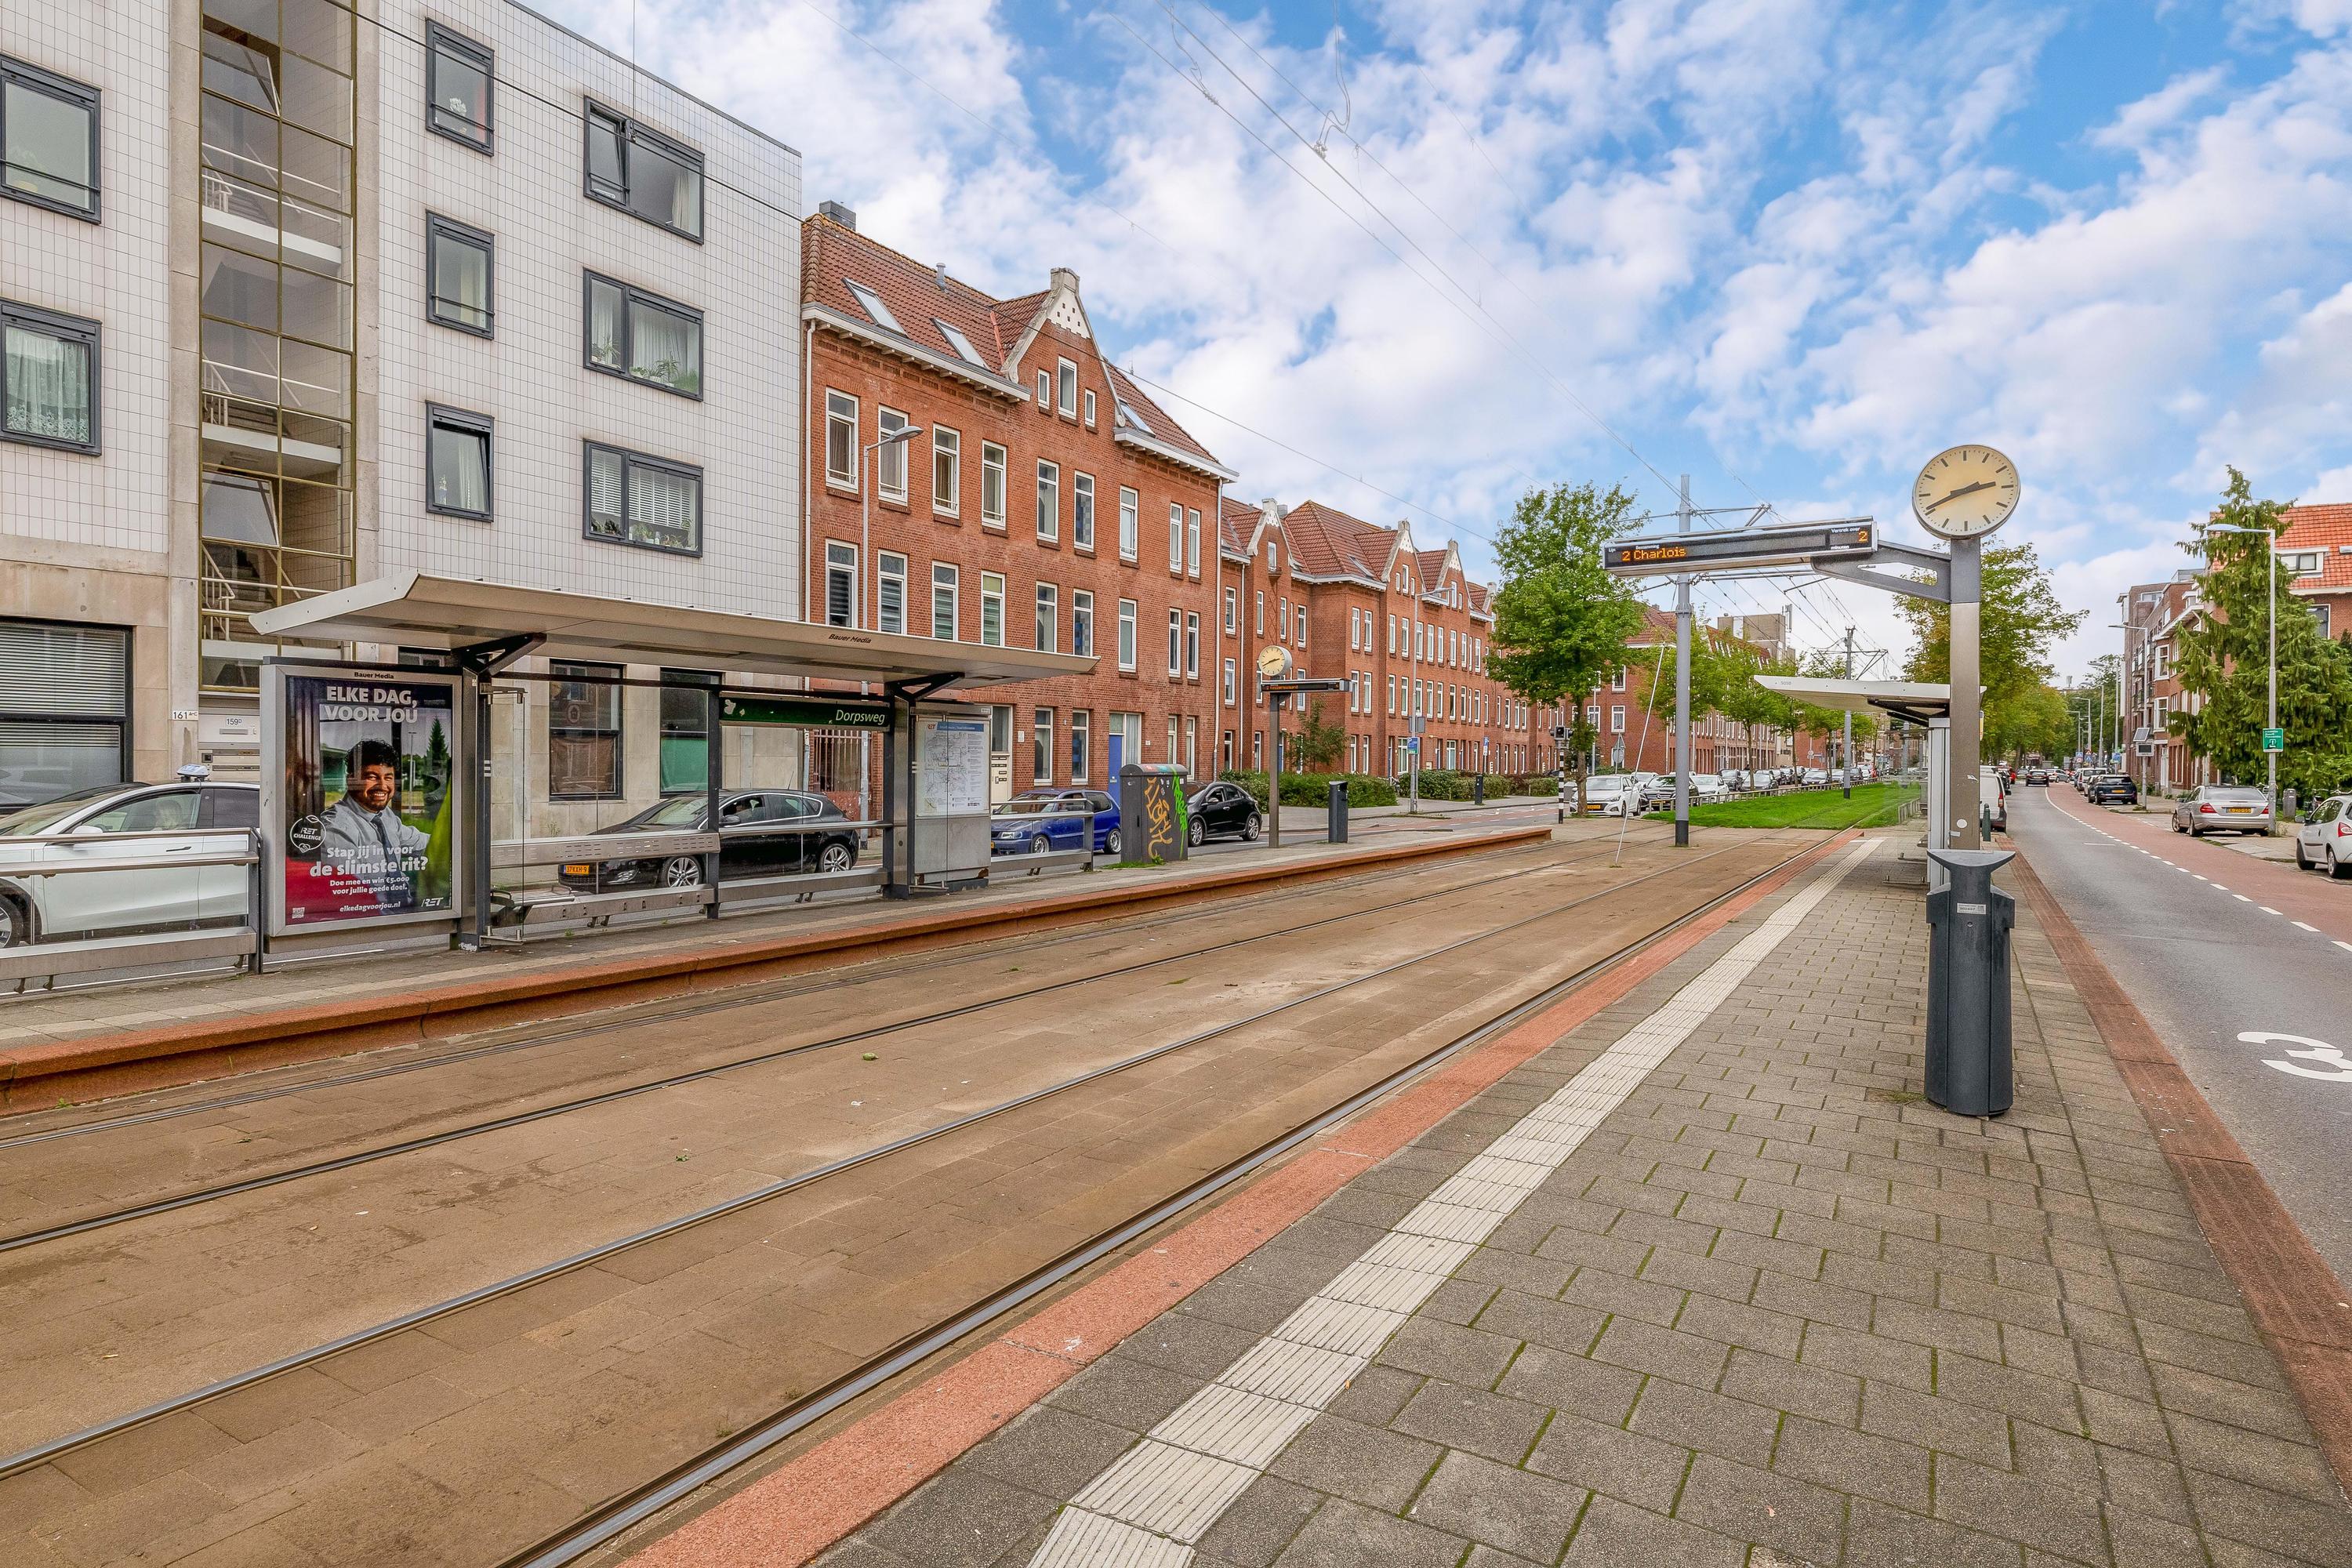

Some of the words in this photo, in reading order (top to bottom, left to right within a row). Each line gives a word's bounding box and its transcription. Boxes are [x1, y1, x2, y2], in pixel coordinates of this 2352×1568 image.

[1858, 531, 1867, 542] 2
[1621, 550, 1631, 561] 2
[1634, 546, 1686, 560] Charlois
[326, 686, 369, 702] ELKE
[373, 688, 418, 708] DAG,
[325, 706, 379, 722] VOOR
[384, 707, 418, 723] JOU
[835, 710, 885, 724] Dorpsweg
[327, 847, 355, 859] Stap
[357, 845, 370, 858] jij
[372, 845, 383, 855] in
[387, 845, 414, 855] voor
[310, 861, 332, 877] de
[337, 859, 397, 876] slimste
[401, 856, 429, 872] rit?
[349, 886, 368, 895] jullie
[368, 885, 390, 894] goede
[339, 902, 401, 913] elkedagvoorjou.nl
[421, 897, 444, 908] RET
